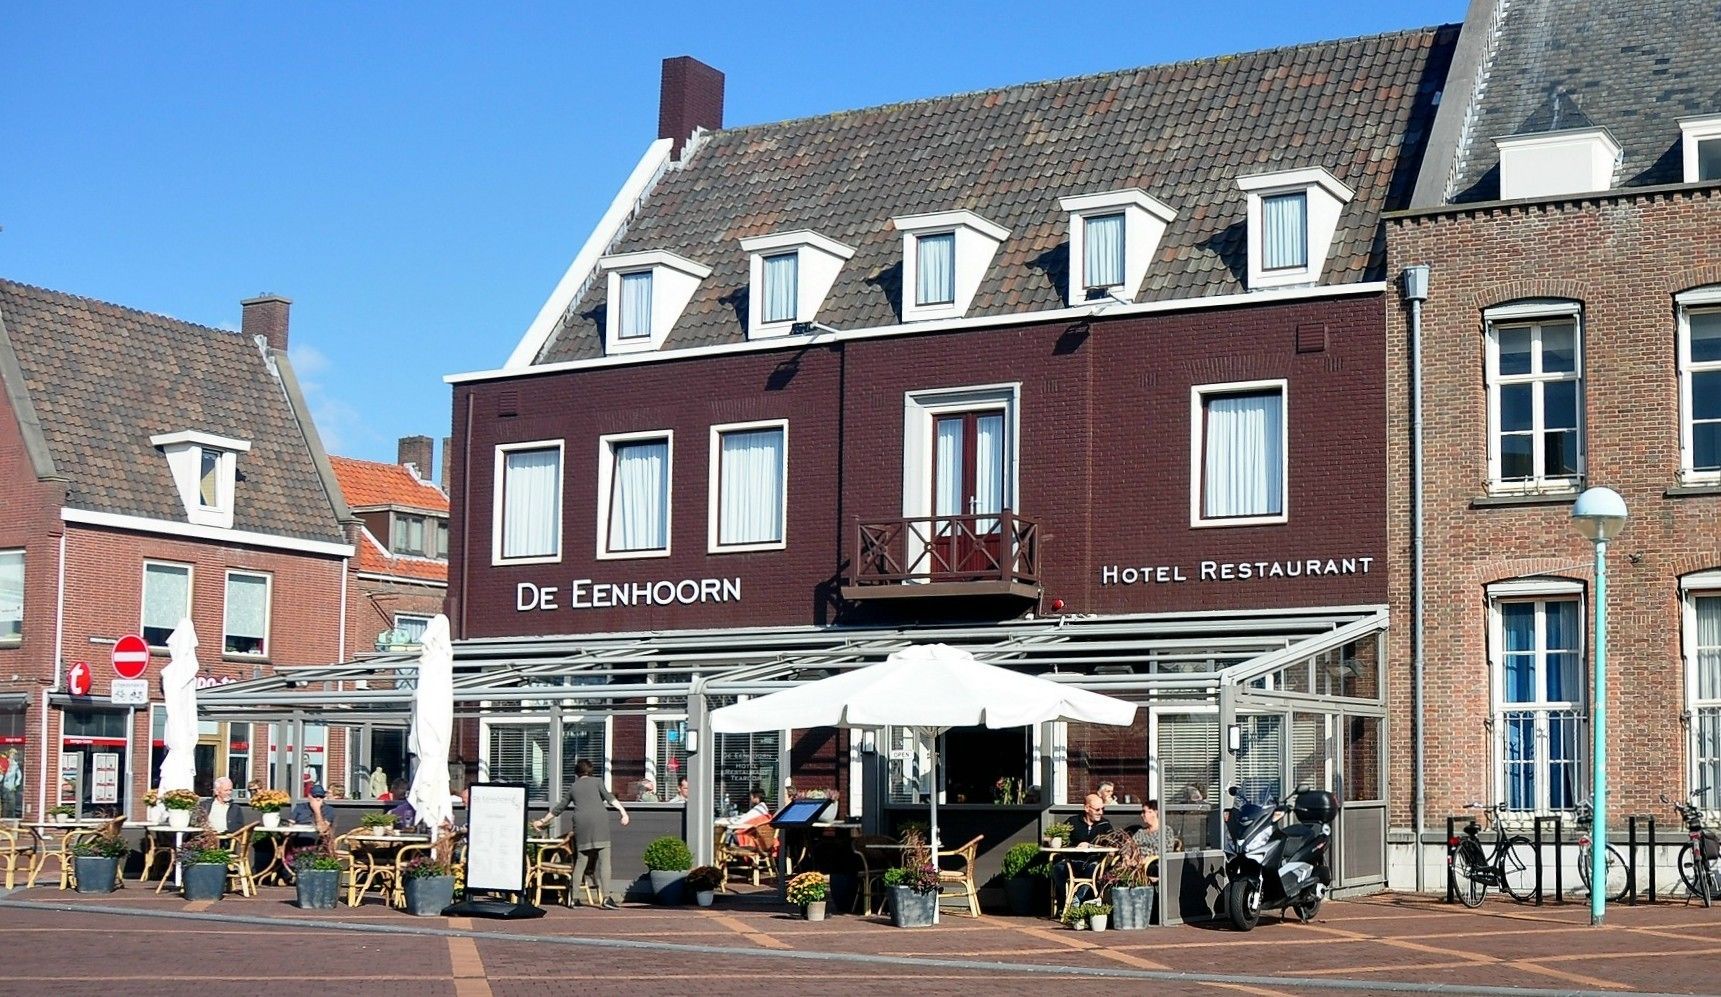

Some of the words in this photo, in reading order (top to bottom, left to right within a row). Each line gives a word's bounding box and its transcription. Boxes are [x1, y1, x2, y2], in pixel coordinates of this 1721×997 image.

[1102, 565, 1187, 585] HOTEL
[1200, 557, 1374, 581] RESTAURANT
[70, 663, 84, 695] t
